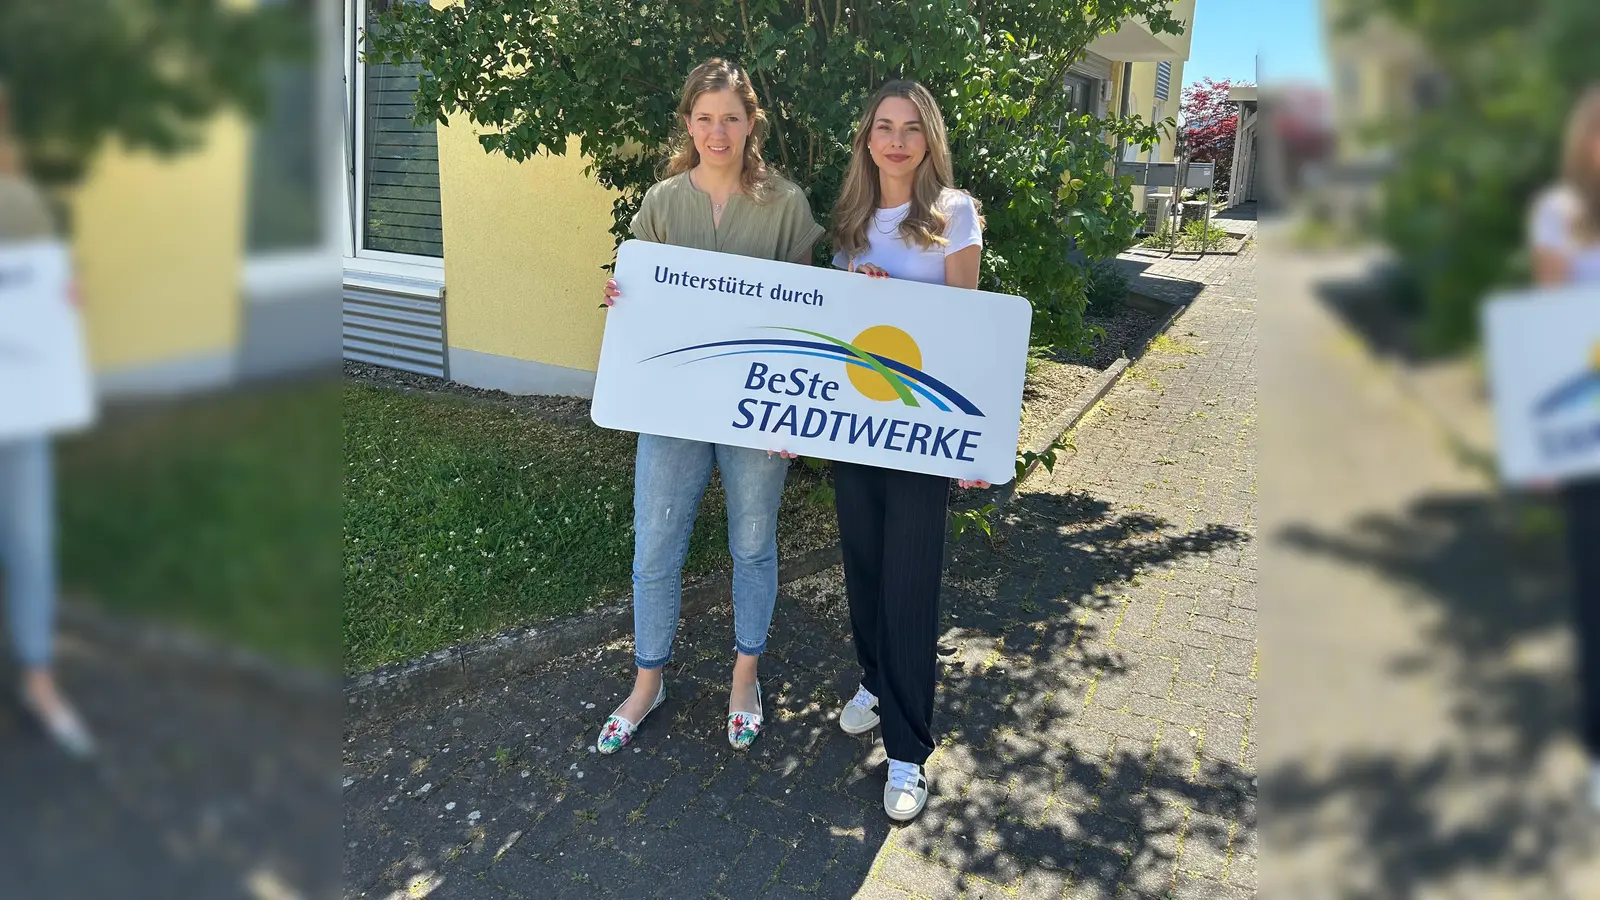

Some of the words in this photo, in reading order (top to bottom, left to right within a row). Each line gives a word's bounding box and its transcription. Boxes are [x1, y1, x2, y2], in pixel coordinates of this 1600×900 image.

[653, 265, 765, 298] Unterstützt
[769, 282, 825, 307] durch
[744, 361, 840, 402] BeSte
[731, 397, 982, 463] STADTWERKE
